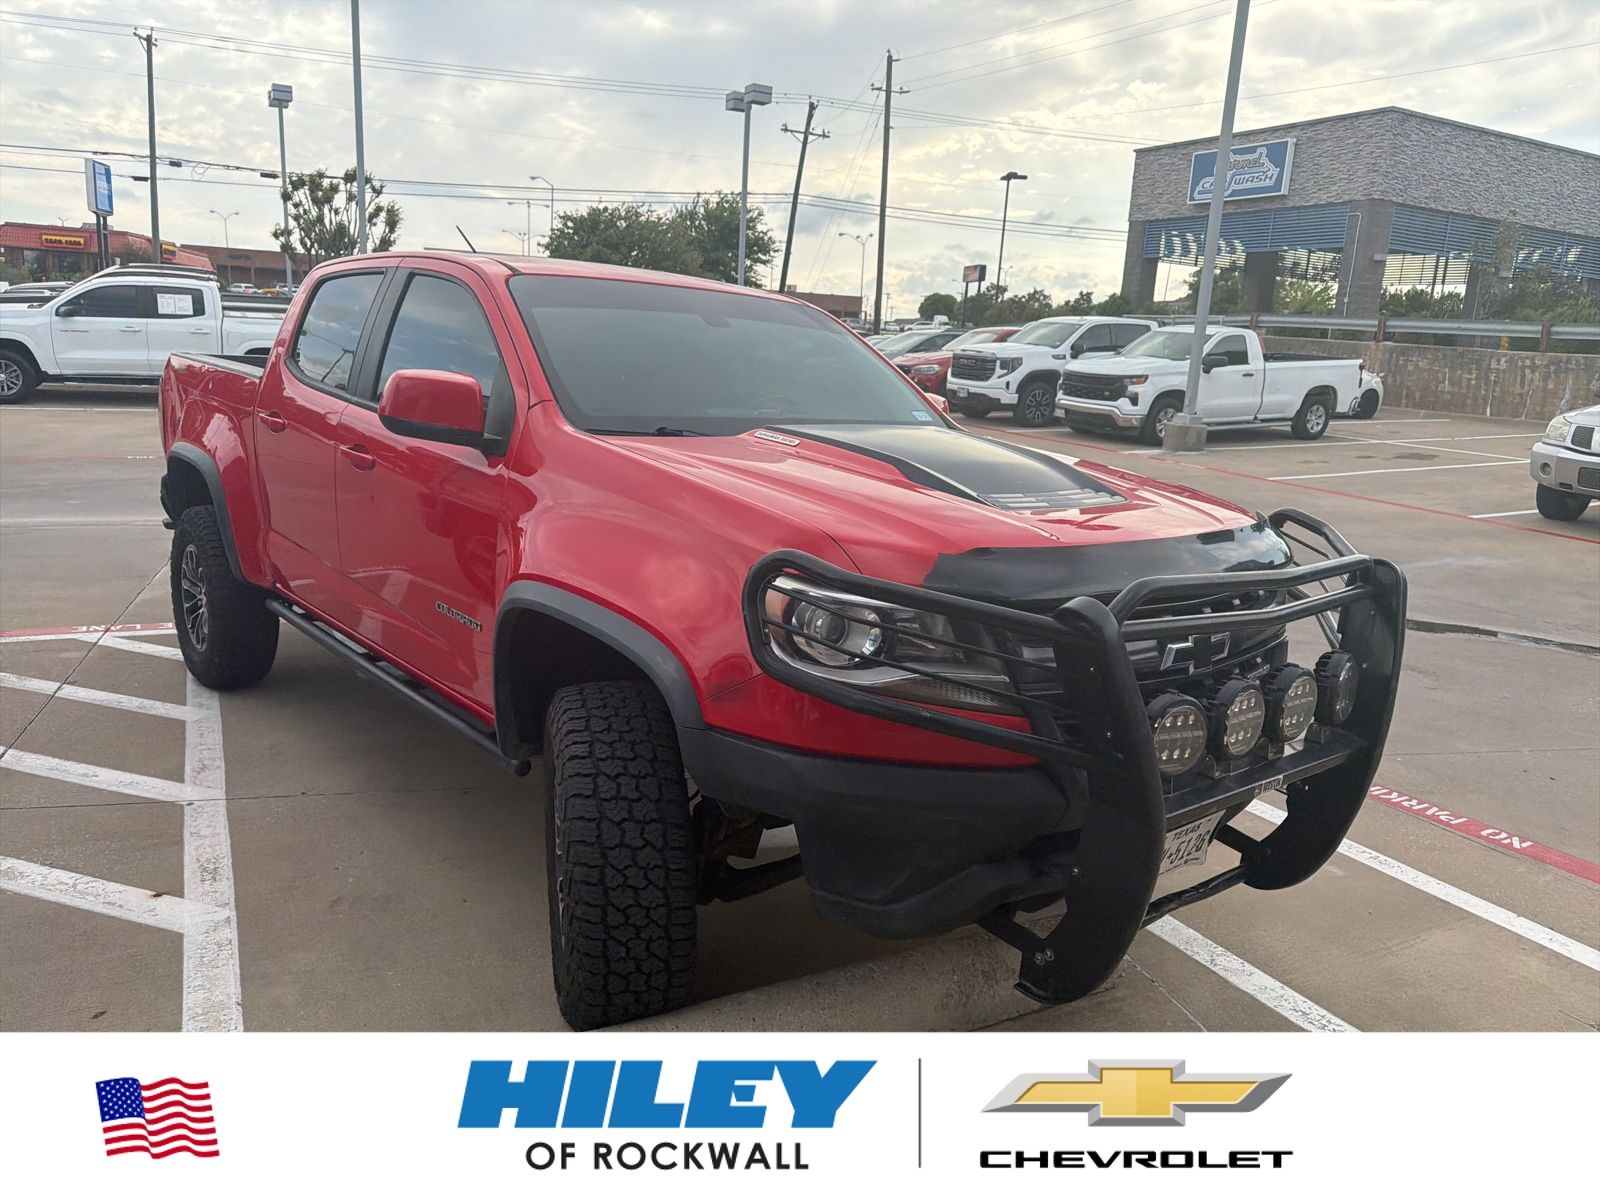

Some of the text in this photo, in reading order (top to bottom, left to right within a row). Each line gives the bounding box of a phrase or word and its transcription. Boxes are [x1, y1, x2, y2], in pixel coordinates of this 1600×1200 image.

[1234, 173, 1274, 185] WASH
[71, 624, 141, 633] LANE
[1369, 786, 1534, 849] NO PARKI
[1171, 821, 1203, 842] TEXAS
